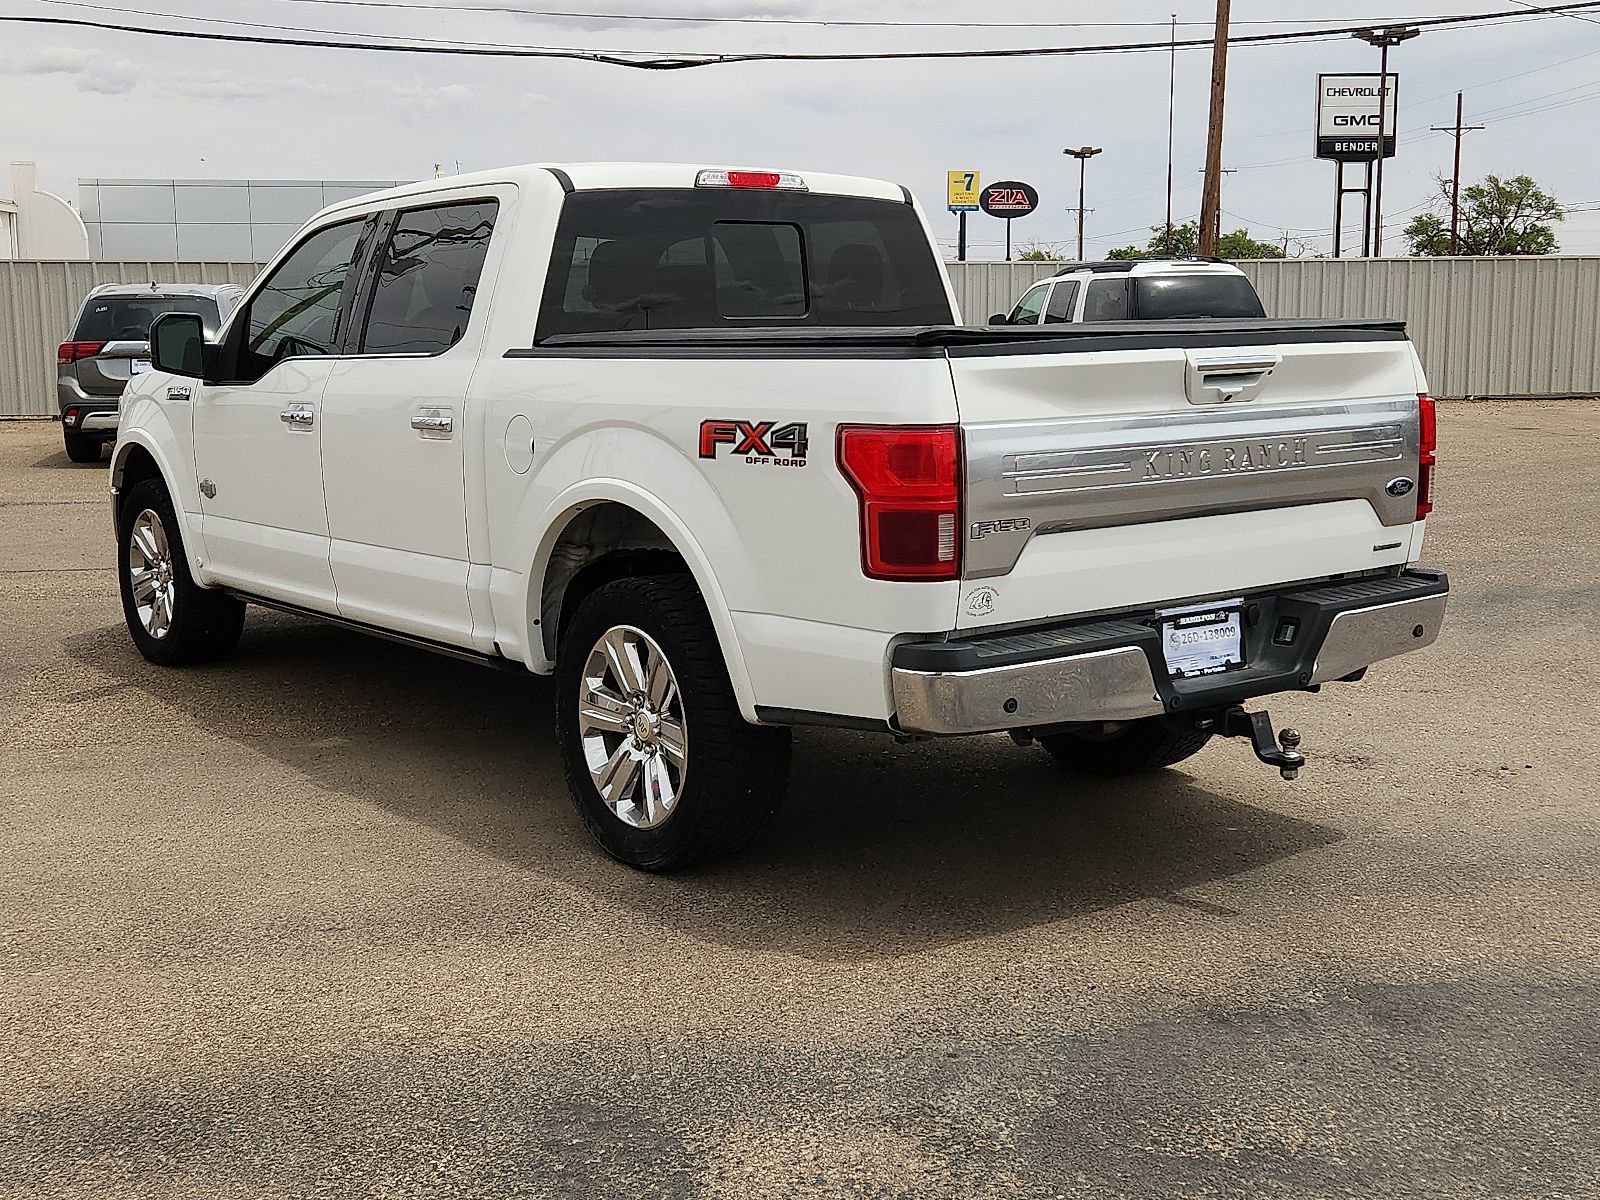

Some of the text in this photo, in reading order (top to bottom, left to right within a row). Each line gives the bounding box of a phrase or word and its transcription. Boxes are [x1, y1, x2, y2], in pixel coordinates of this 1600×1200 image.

[1333, 114, 1381, 126] GMC
[1335, 142, 1378, 152] BENDER
[988, 188, 1029, 204] ZIA
[699, 419, 808, 459] FX4
[745, 456, 807, 467] OFF ROAD
[1142, 437, 1308, 479] KING RANCH
